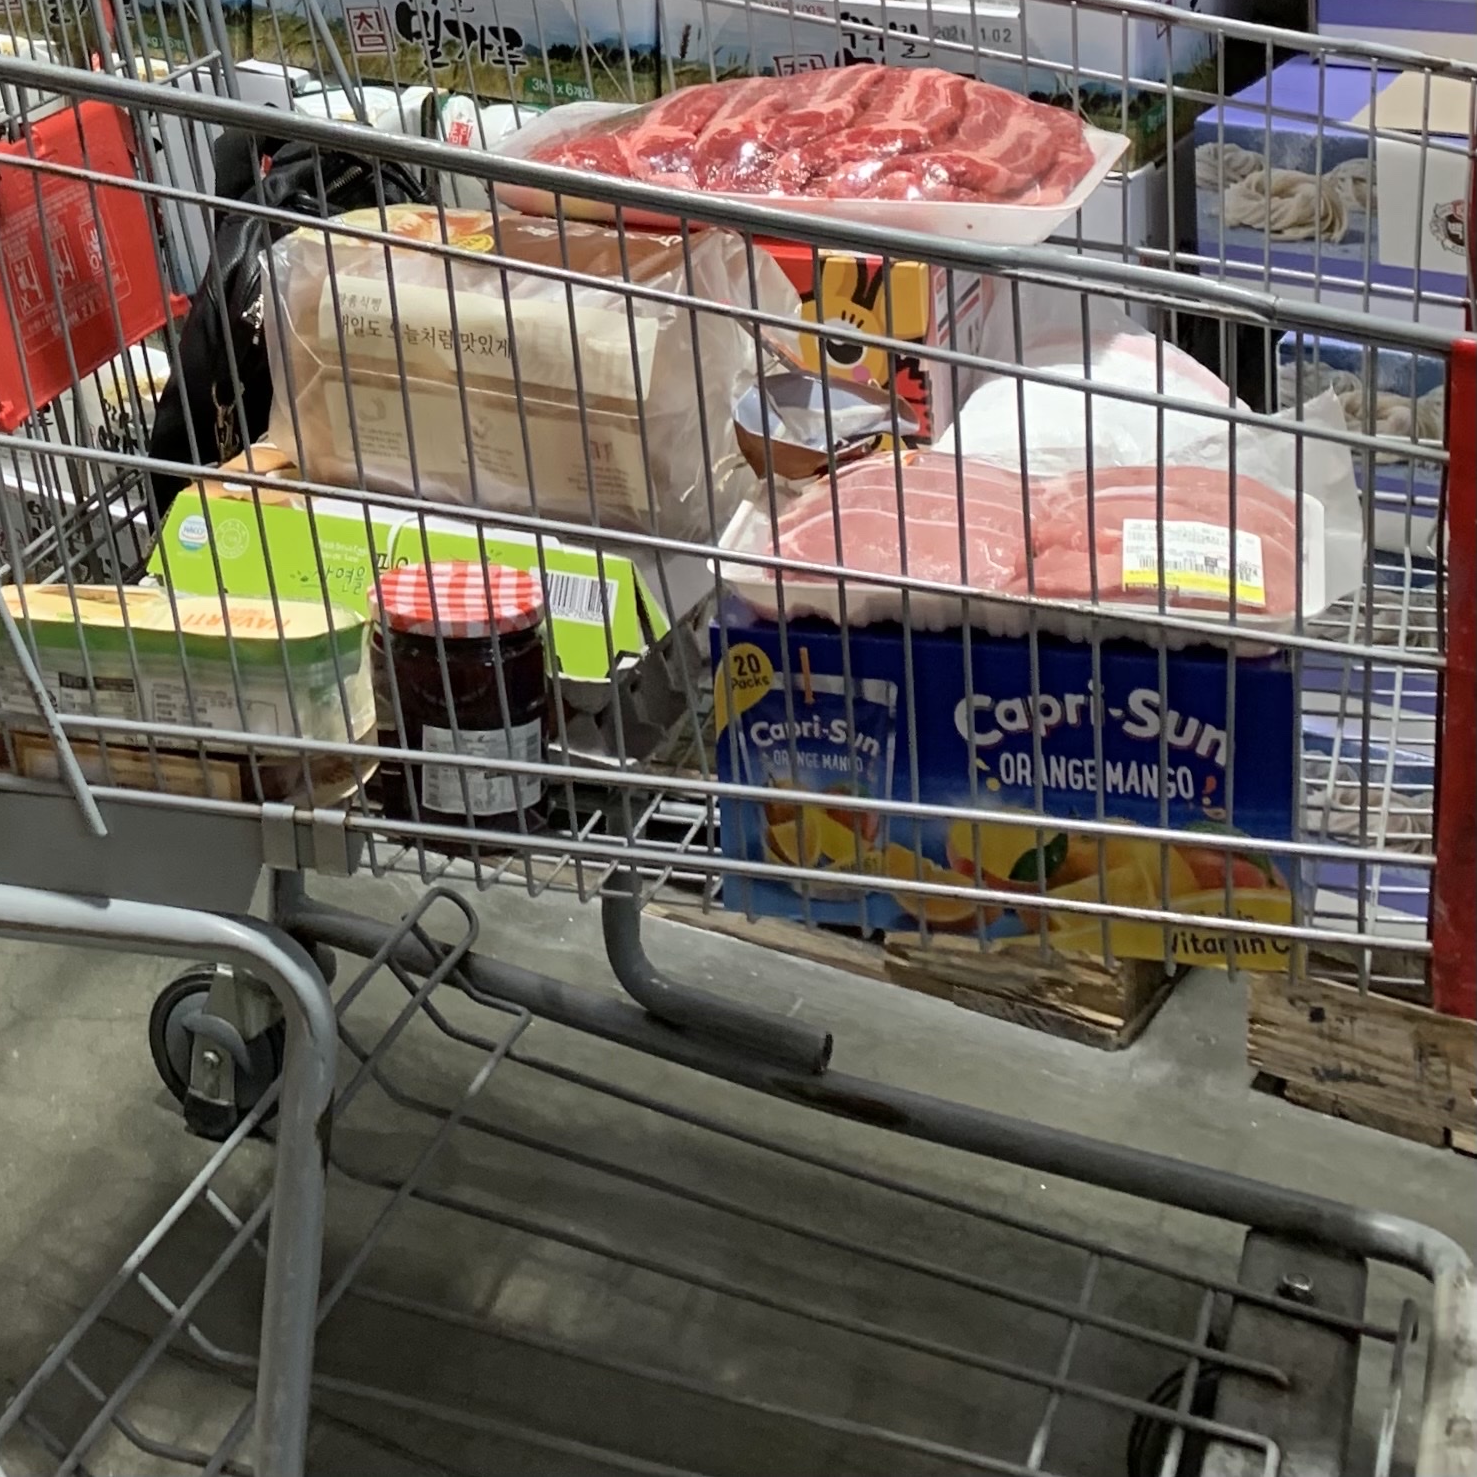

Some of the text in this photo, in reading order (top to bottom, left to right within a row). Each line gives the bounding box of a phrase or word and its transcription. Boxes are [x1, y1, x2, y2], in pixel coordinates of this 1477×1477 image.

[395, 0, 528, 74] 밀가루
[460, 333, 512, 359] 맛있게
[734, 653, 761, 676] 20
[731, 675, 770, 691] Packs
[954, 678, 1237, 768] Capri-Sun
[773, 749, 863, 771] ORNGE MANO
[999, 750, 1195, 802] ORANGE MANGO
